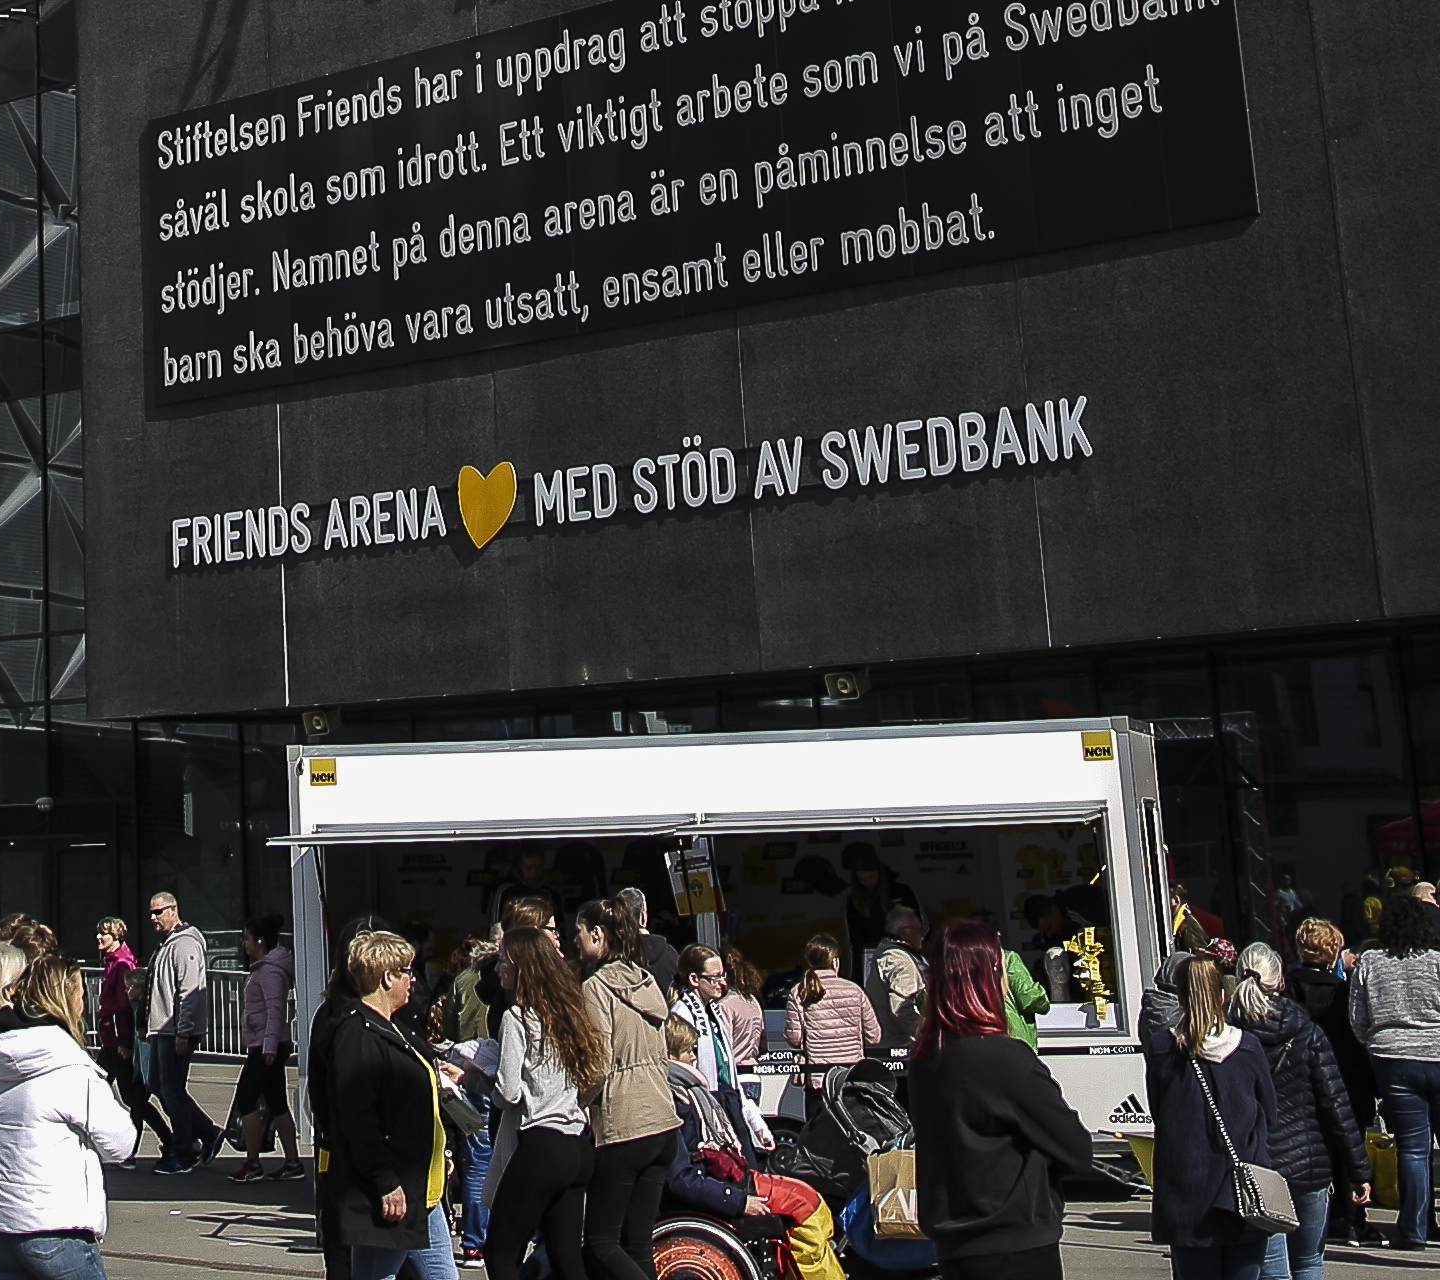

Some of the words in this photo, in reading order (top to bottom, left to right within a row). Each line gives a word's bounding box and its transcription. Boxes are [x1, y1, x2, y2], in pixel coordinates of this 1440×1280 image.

[157, 113, 286, 170] Stiftelsen
[297, 76, 403, 137] Friends
[414, 66, 464, 109] har
[475, 51, 483, 94] i
[495, 28, 626, 96] uppdrag
[640, 0, 687, 53] att
[159, 188, 229, 241] såväl
[239, 172, 316, 223] skola
[326, 163, 386, 206] som
[397, 130, 487, 190] idrott.
[500, 115, 546, 167] Ett
[557, 88, 663, 153] viktigt
[676, 63, 789, 128] arbete
[803, 51, 878, 98] som
[893, 25, 925, 77] vi
[943, 12, 990, 80] på
[160, 261, 261, 315] stödjer.
[271, 230, 381, 293] Namnet
[392, 221, 428, 281] på
[439, 213, 532, 259] denna
[544, 190, 637, 237] arena
[650, 168, 685, 215] är
[699, 167, 738, 206] en
[754, 115, 968, 209] påminnelse
[984, 90, 1042, 147] att
[1057, 63, 1163, 139] inget
[163, 345, 222, 387] barn
[233, 330, 282, 374] ska
[293, 311, 395, 364] behöva
[406, 302, 474, 344] vara
[485, 270, 590, 330] utsatt,
[602, 242, 728, 308] ensamt
[742, 230, 825, 283] eller
[840, 192, 995, 266] mobbat.
[171, 502, 312, 569] FRIENDS
[324, 483, 447, 552] ARENA
[533, 462, 618, 528] MED
[632, 434, 737, 514] STÖD
[754, 434, 804, 499] AV
[820, 395, 1094, 492] SWEDBANK
[312, 772, 335, 782] NCH
[1085, 746, 1111, 757] NCH
[1108, 1112, 1153, 1124] adidas
